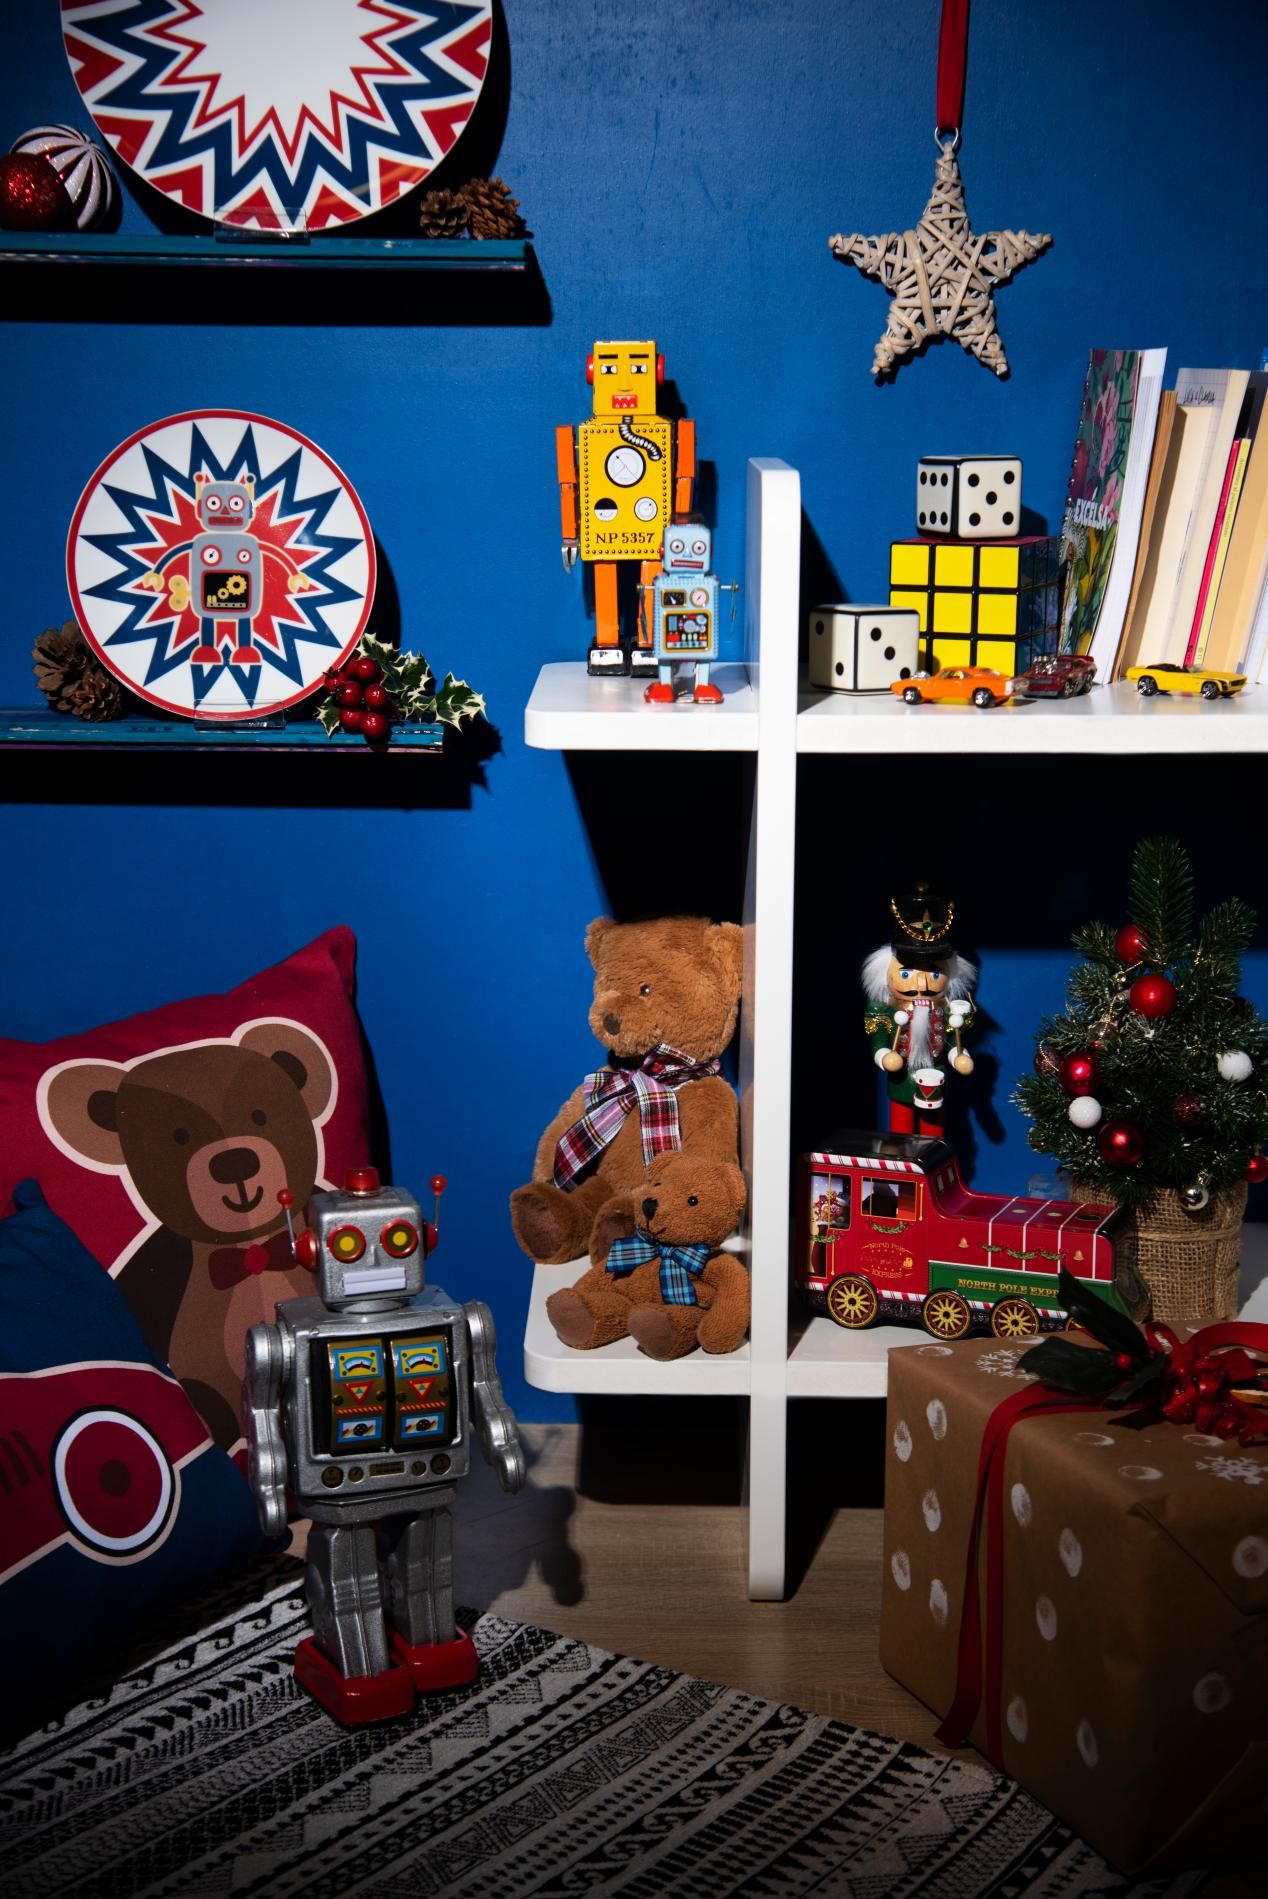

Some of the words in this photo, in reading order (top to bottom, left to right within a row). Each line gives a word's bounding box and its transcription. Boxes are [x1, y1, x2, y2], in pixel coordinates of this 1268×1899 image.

[621, 532, 655, 544] 5357
[958, 1279, 997, 1291] NORTH
[999, 1283, 1028, 1295] POLE
